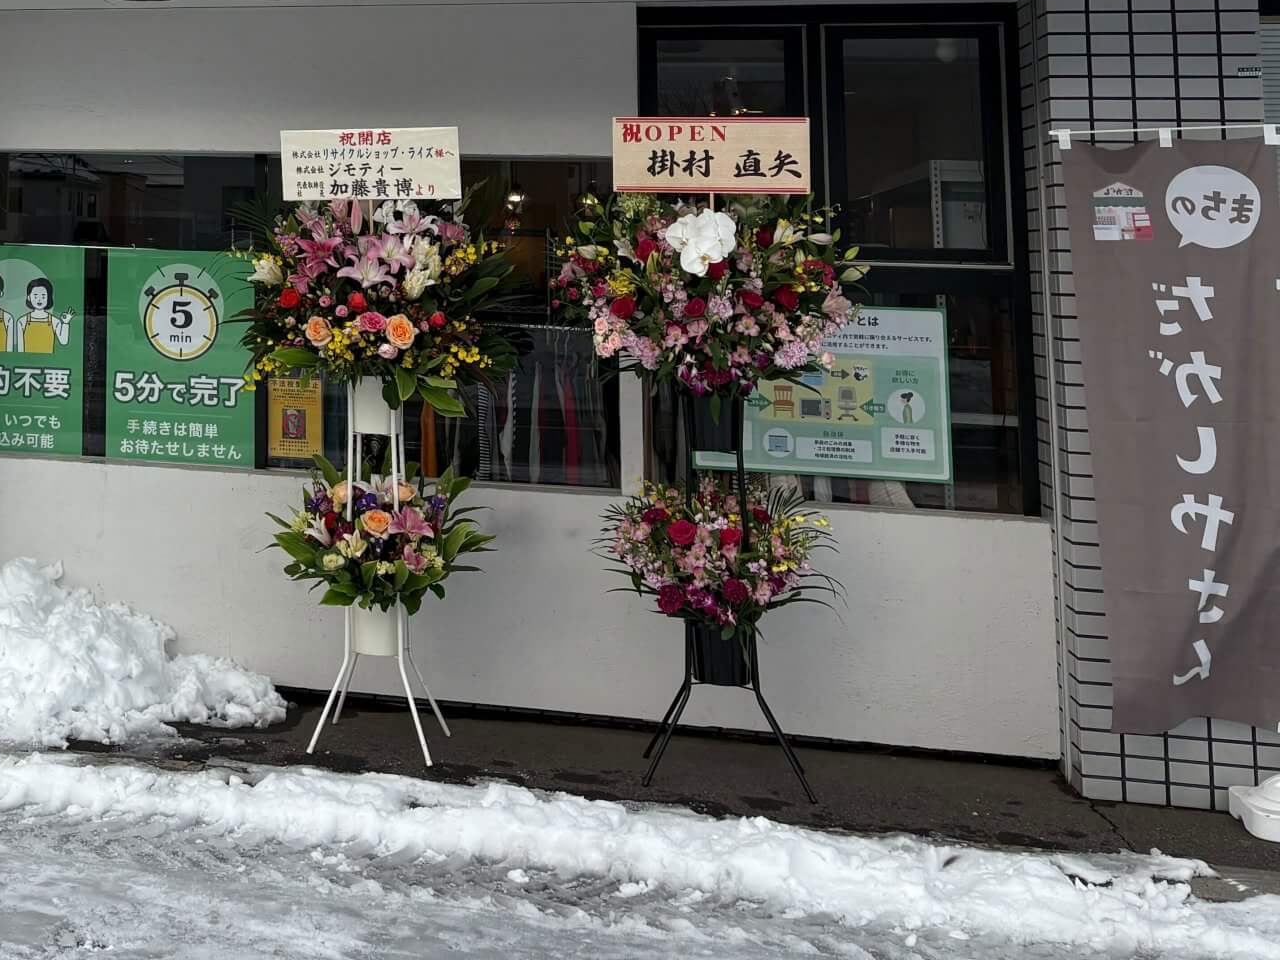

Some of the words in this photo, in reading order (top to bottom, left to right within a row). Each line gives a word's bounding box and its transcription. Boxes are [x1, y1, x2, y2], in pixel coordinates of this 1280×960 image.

[339, 131, 392, 146] 祝開店
[647, 149, 714, 178] 掛村
[734, 149, 802, 178] 直矢
[170, 301, 192, 329] 5
[170, 332, 192, 344] min
[114, 371, 246, 407] 5分で完了
[127, 419, 218, 439] 手続きは簡単
[120, 438, 241, 461] お待たせしません
